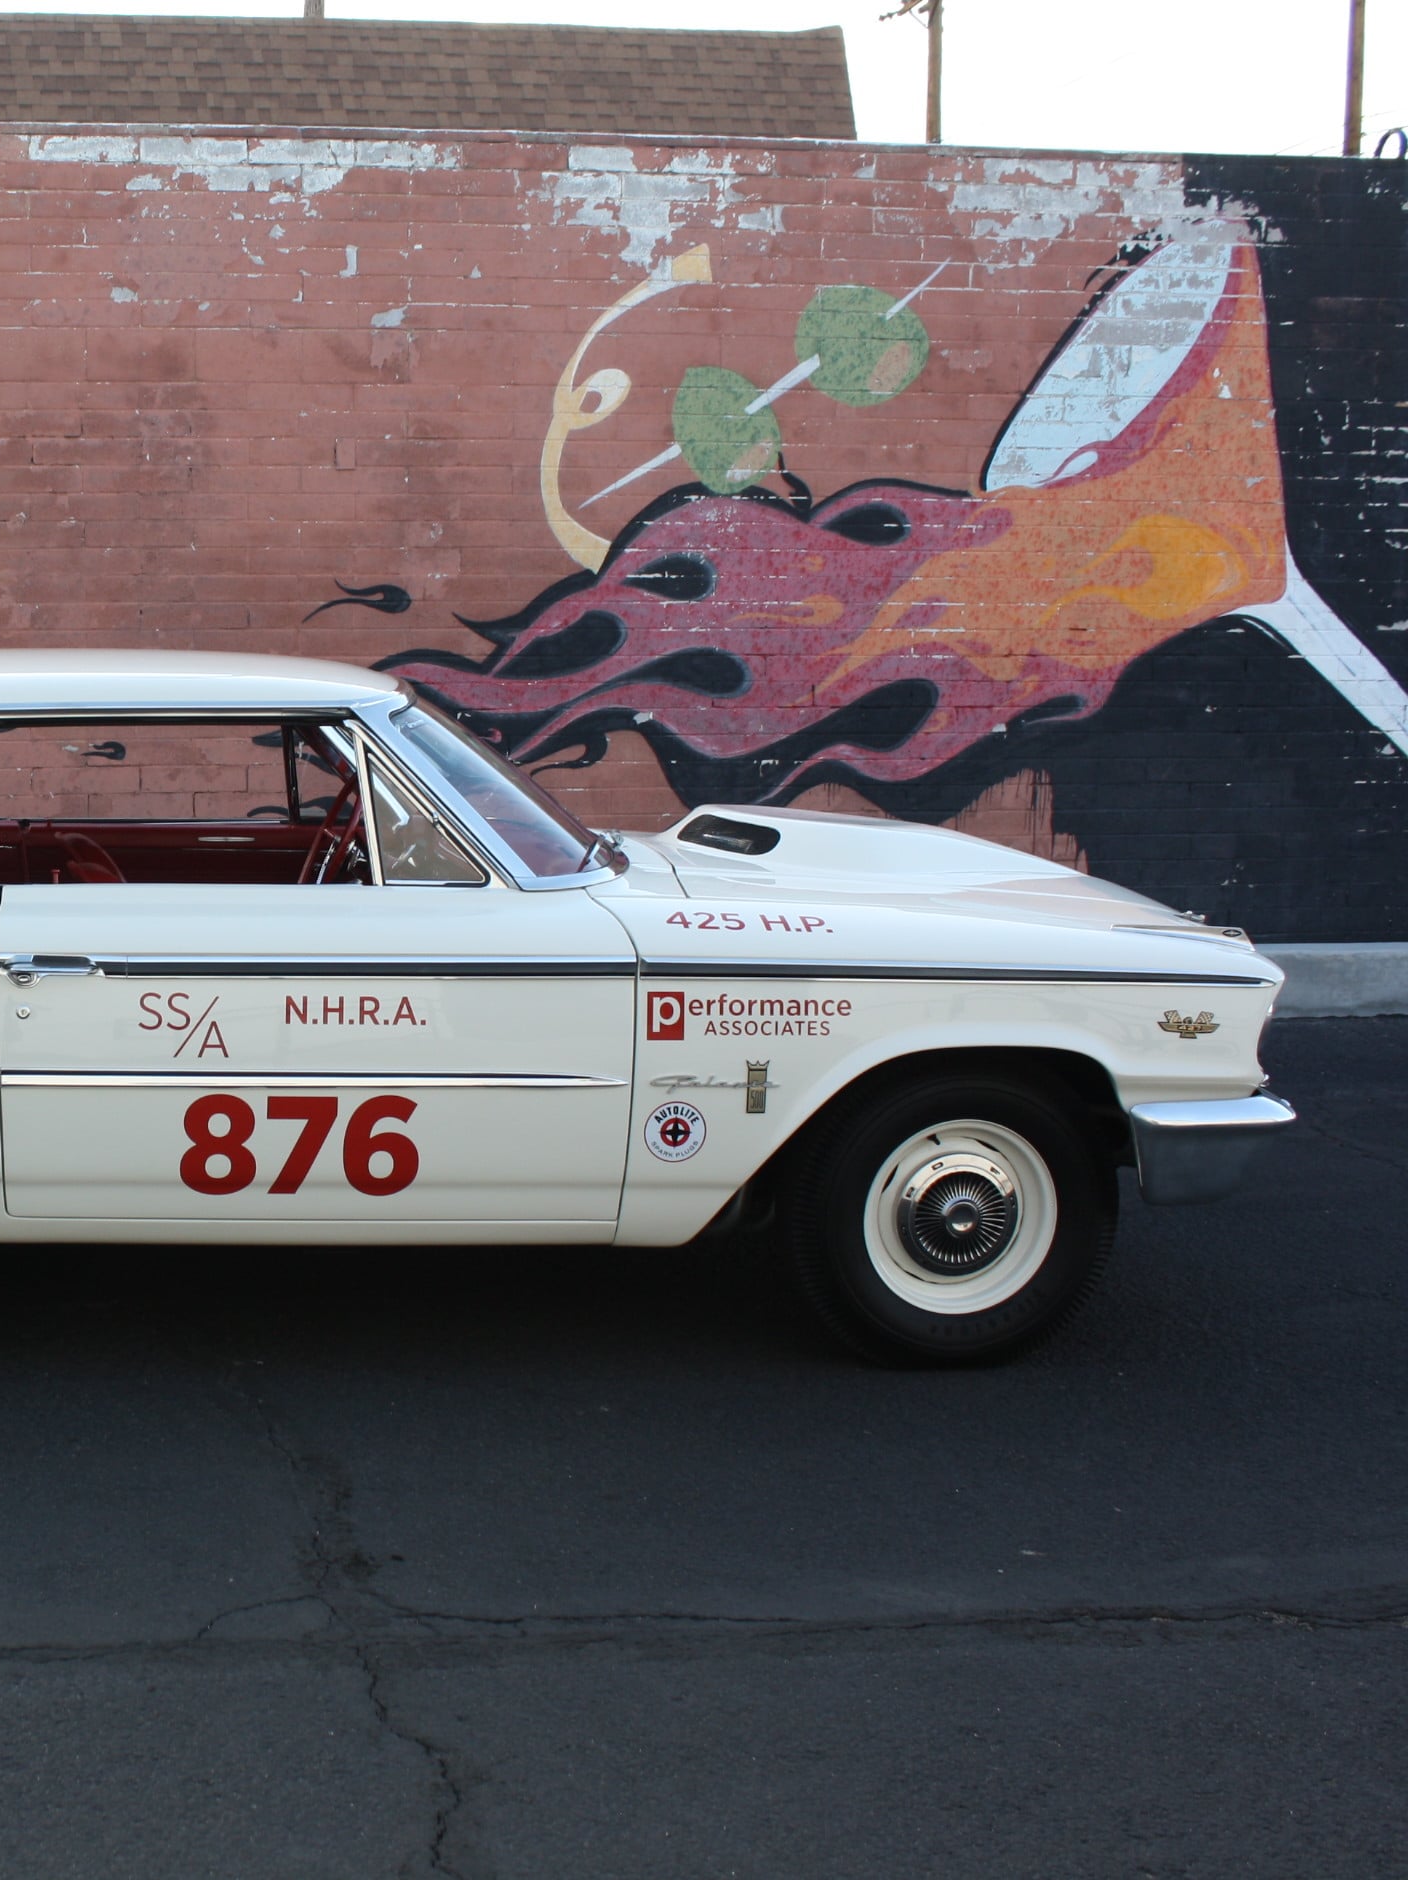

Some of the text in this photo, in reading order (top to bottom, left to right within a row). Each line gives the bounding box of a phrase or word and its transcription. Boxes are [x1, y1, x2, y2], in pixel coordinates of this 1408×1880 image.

[666, 911, 833, 933] 425 H.P.
[284, 995, 428, 1026] N.H.R.A.
[652, 993, 853, 1033] performance
[704, 1020, 831, 1036] ASSOCIATES
[653, 1105, 701, 1126] AUTOLITE
[179, 1093, 420, 1197] 876
[652, 1140, 700, 1158] SPARK PLUGS
